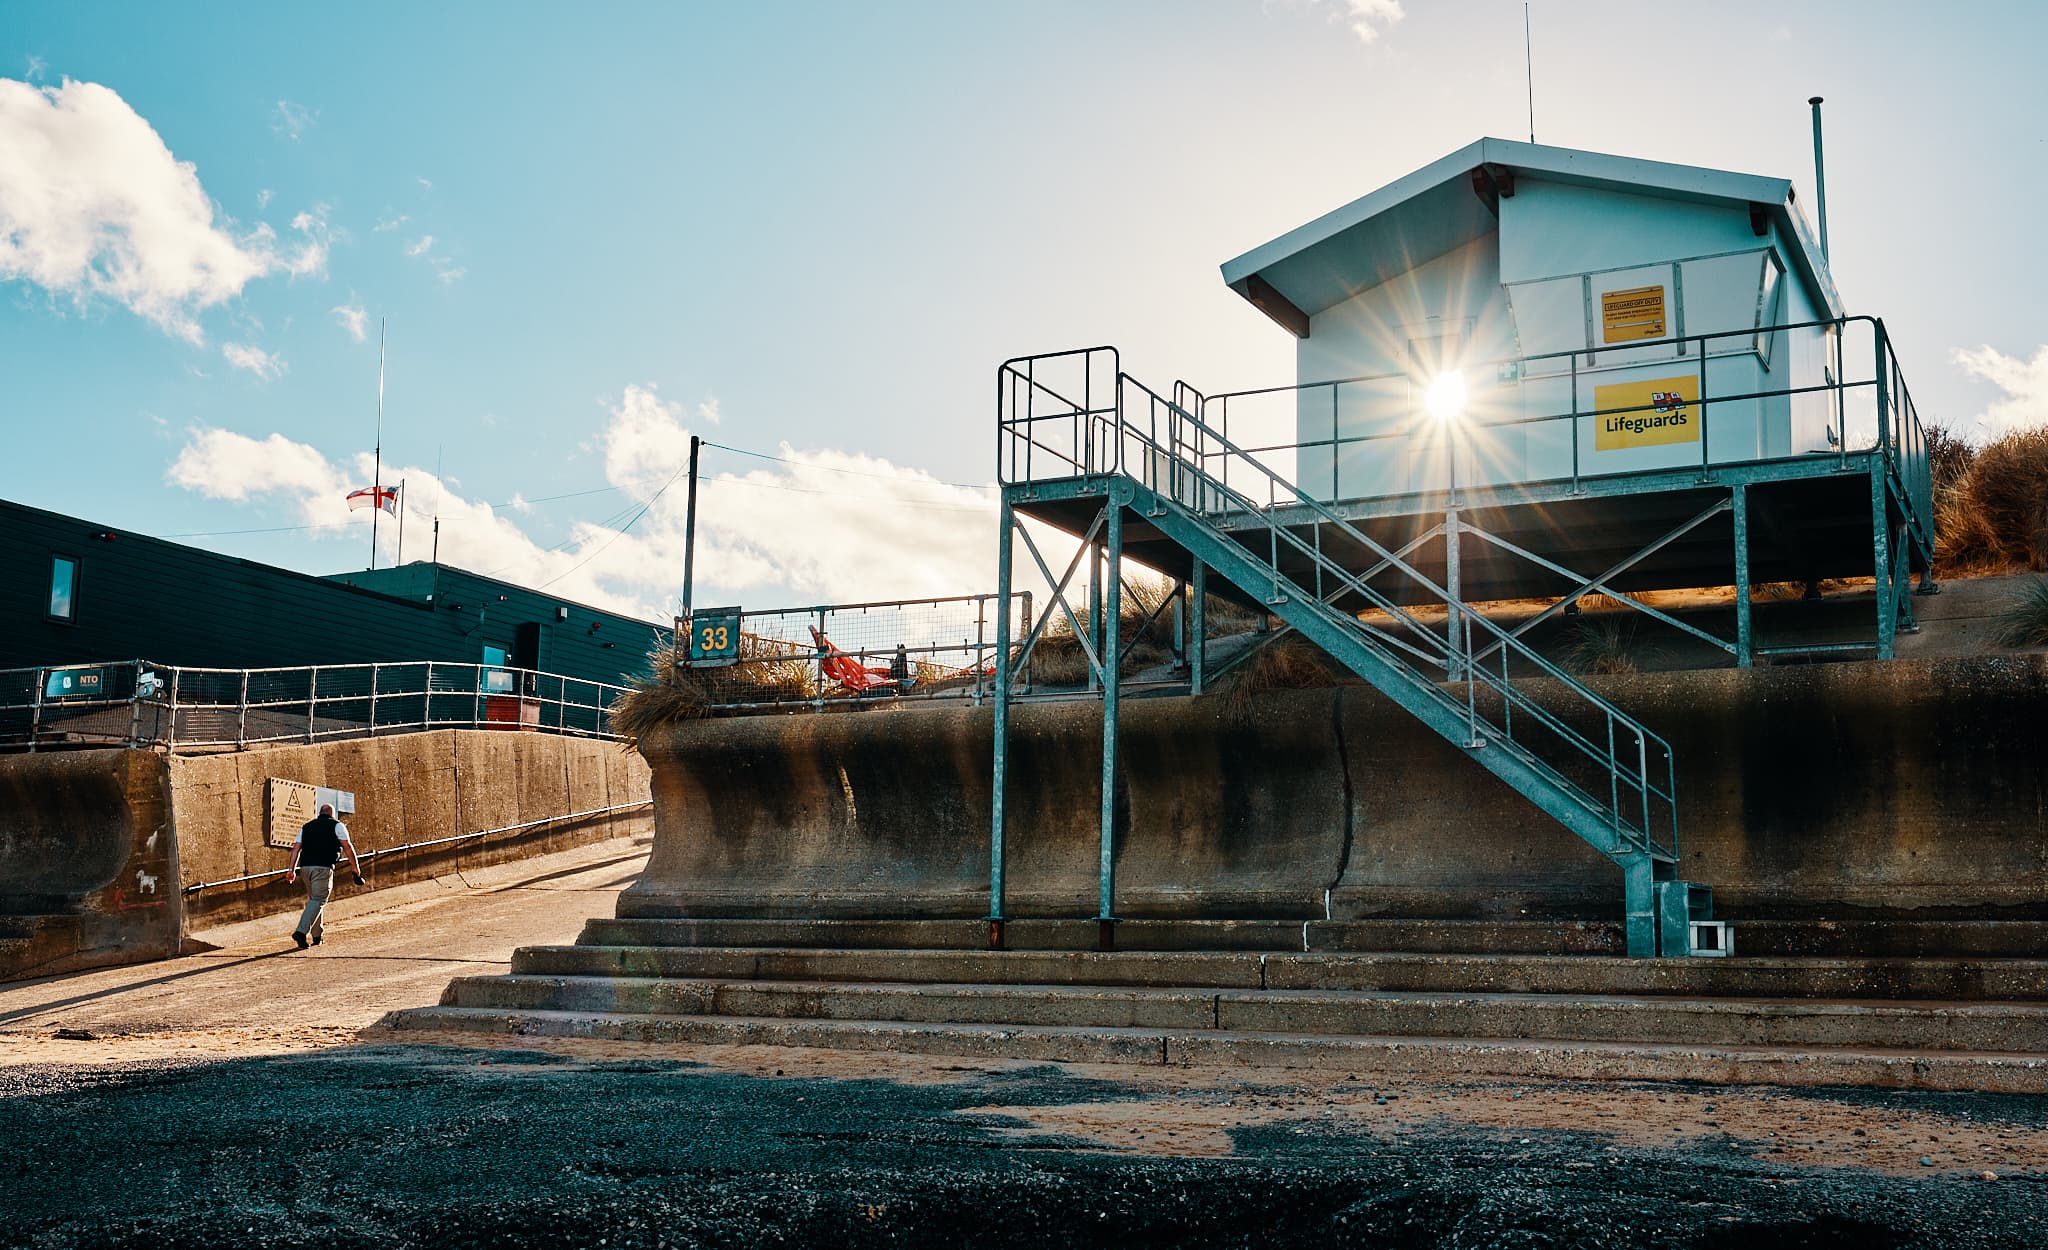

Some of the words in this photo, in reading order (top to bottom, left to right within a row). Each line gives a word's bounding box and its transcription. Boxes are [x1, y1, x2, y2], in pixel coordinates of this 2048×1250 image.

[1606, 411, 1687, 433] Lifeguards
[701, 626, 727, 650] 33
[80, 675, 98, 684] NTO
